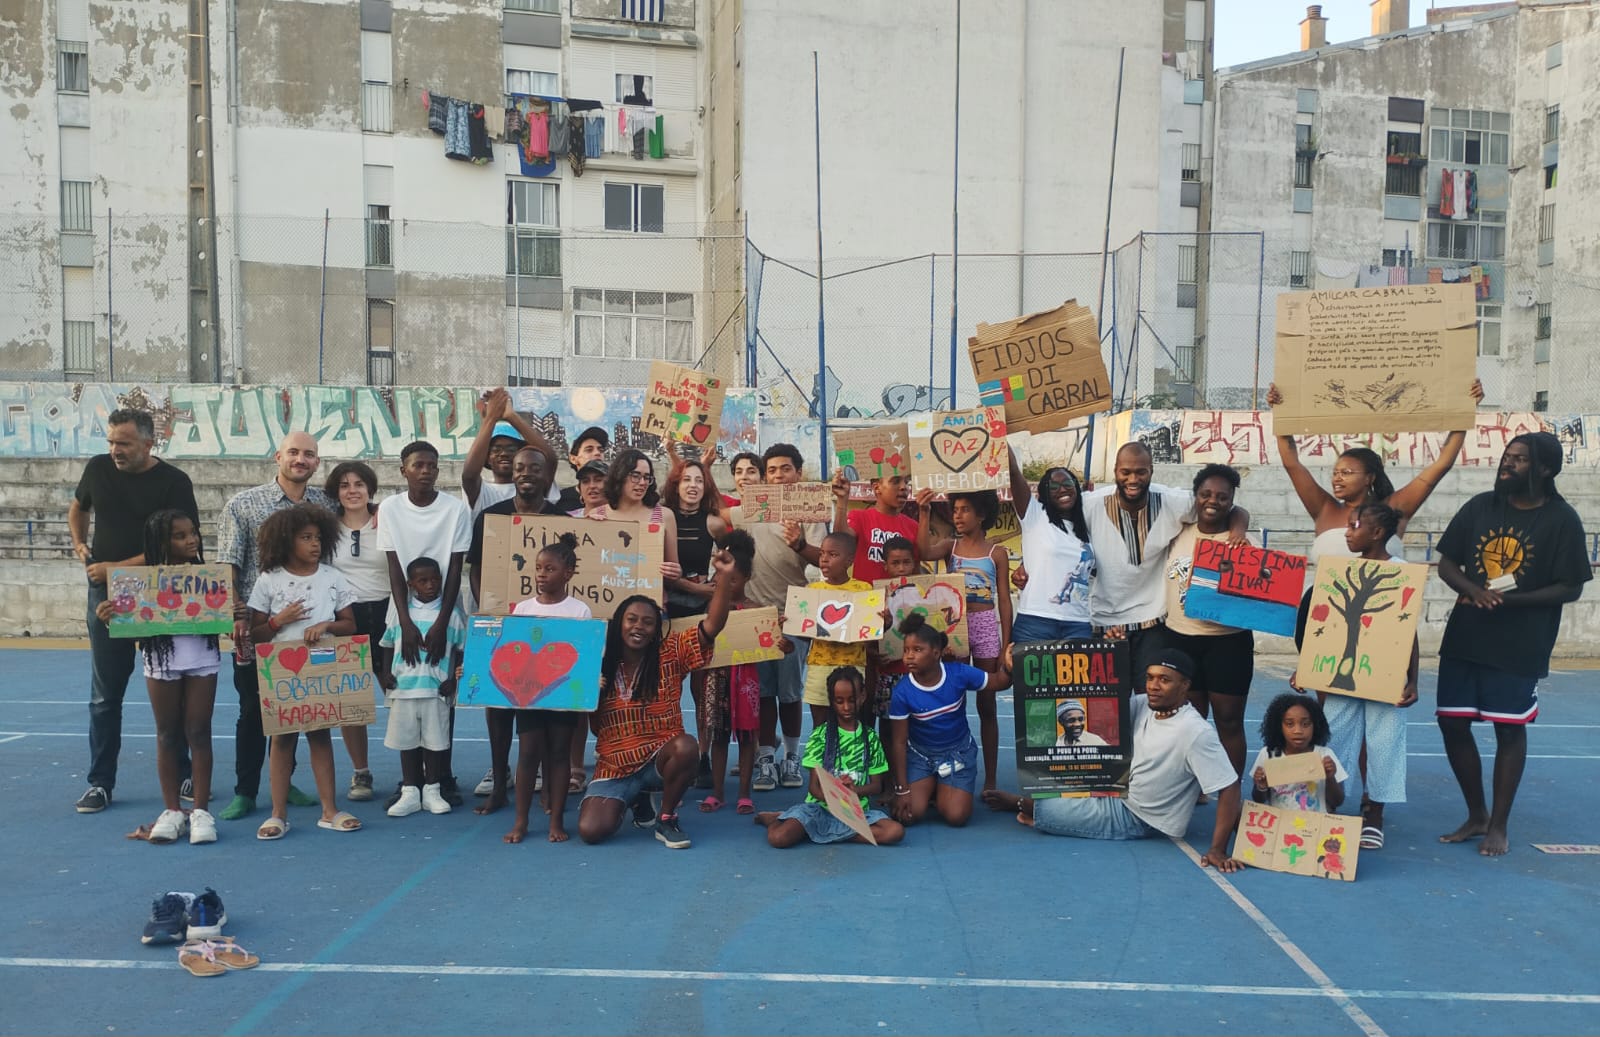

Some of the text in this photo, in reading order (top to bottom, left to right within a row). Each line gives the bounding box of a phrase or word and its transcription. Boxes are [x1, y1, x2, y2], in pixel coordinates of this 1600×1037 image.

[1309, 290, 1358, 303] AMILCAR
[1362, 288, 1414, 297] CABRAL
[972, 327, 1074, 375] FIDJOS
[1027, 363, 1061, 389] DI
[1027, 377, 1110, 416] CABRAL
[943, 438, 979, 457] PAZ
[1023, 653, 1119, 686] CABRAL
[1312, 654, 1373, 677] AMOR
[275, 671, 372, 702] OBRIGADO
[277, 701, 347, 728] KABRAL
